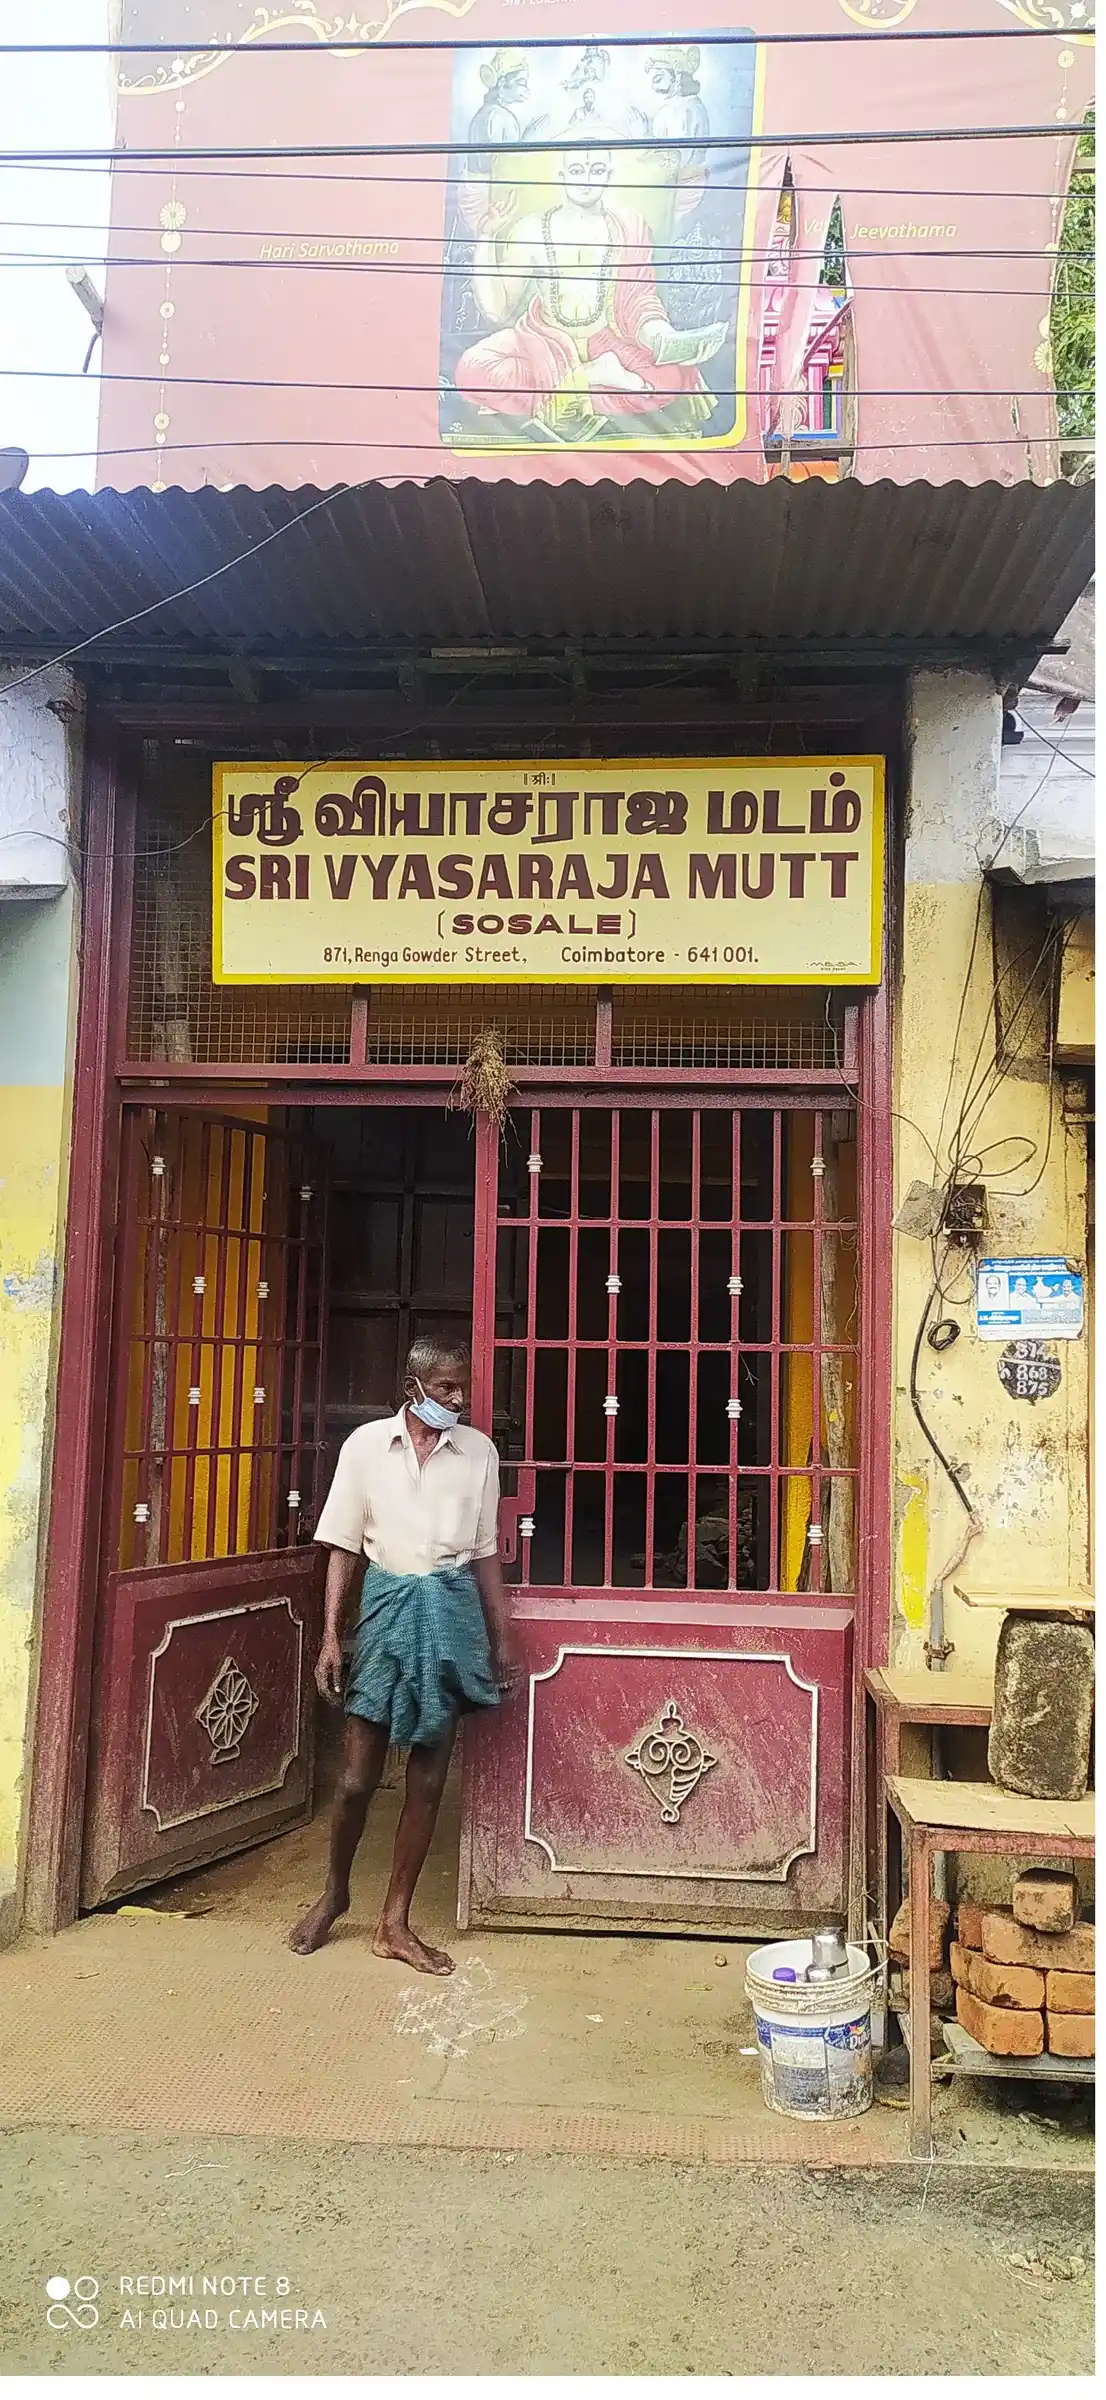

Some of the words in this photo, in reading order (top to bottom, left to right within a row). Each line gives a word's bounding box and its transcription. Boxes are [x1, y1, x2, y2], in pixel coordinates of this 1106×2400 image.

[850, 222, 957, 240] Jeevothama
[259, 243, 295, 259] Hari
[298, 240, 400, 258] Sarvothama
[315, 776, 689, 844] வியாசராஜ
[706, 772, 861, 835] மடம்
[225, 854, 309, 900] SRI
[324, 853, 670, 900] VYASARAJA
[689, 852, 859, 899] MUTT
[354, 947, 398, 967] Renga
[402, 947, 457, 963] Gowder
[465, 946, 527, 964] Street,
[561, 945, 665, 963] Coimbatore
[1016, 1365, 1048, 1381] 868
[1016, 1380, 1049, 1395] 875
